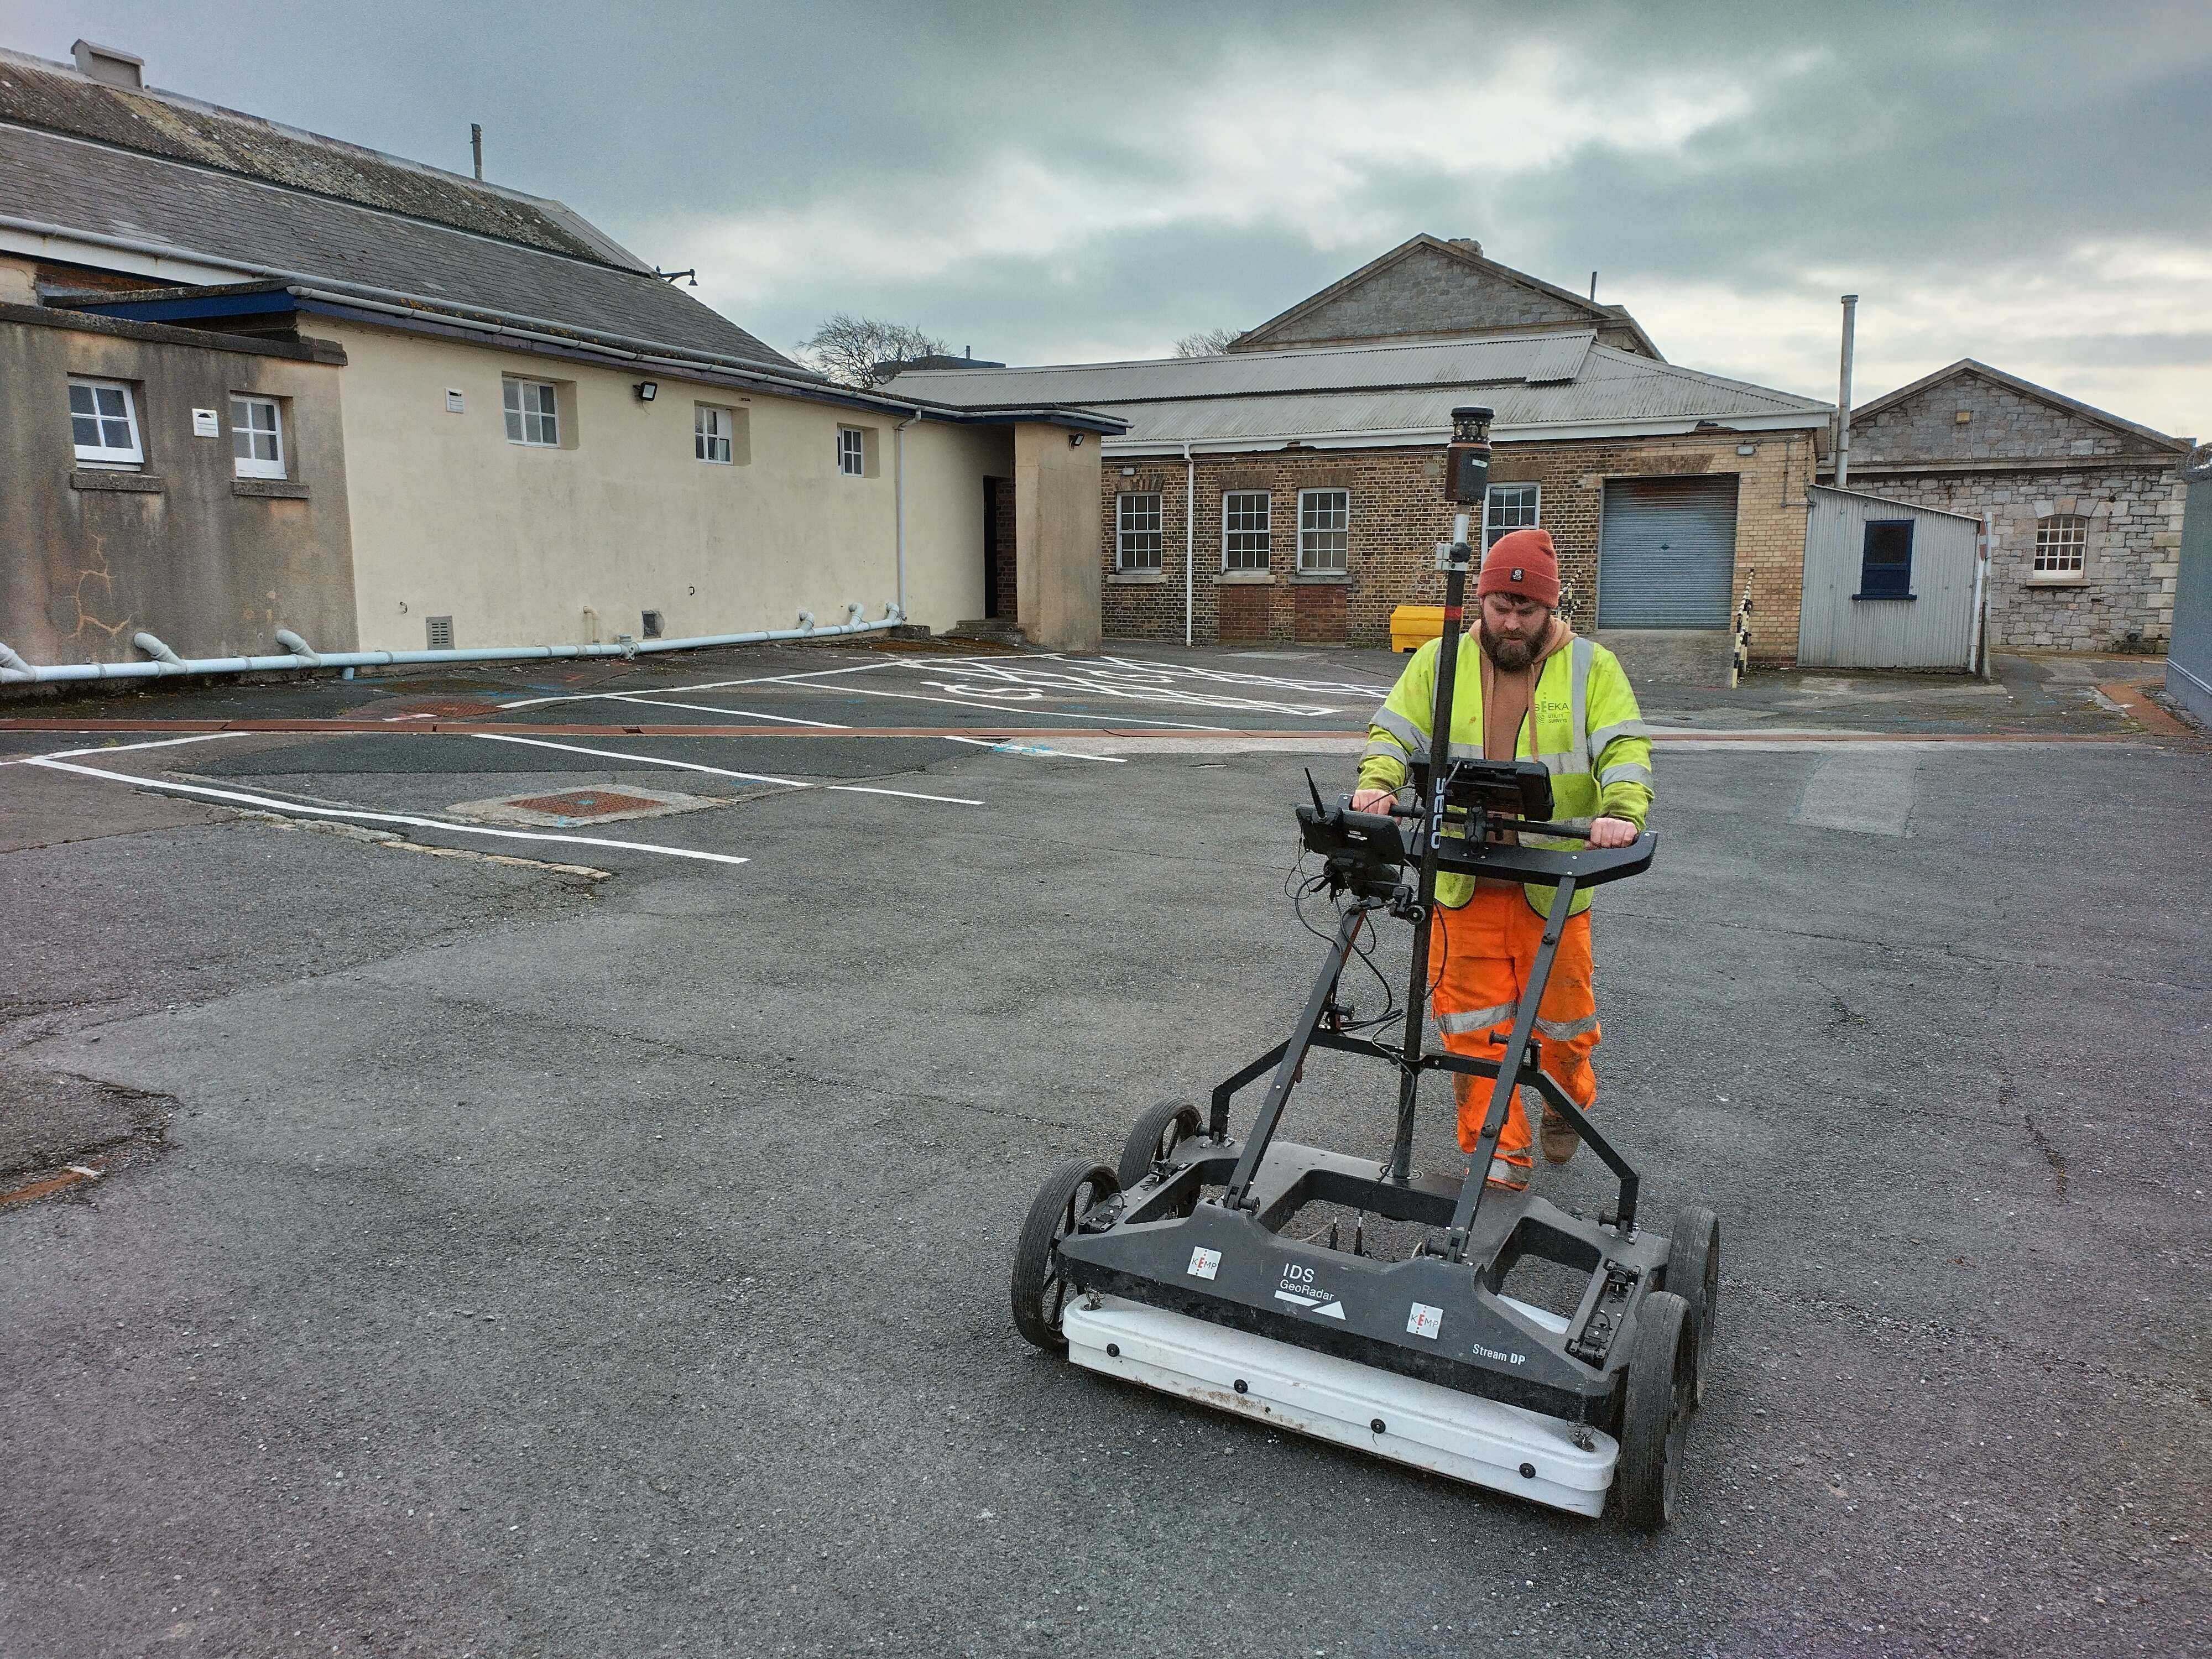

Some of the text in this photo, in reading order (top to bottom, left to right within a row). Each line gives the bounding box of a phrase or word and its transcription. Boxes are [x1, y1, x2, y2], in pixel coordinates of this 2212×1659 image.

[1192, 1257, 1217, 1270] KEMP
[1283, 1262, 1315, 1283] IDS
[1280, 1279, 1335, 1301] GeoRadar
[1410, 1313, 1439, 1328] KEMP
[1472, 1343, 1526, 1365] Stream DP
